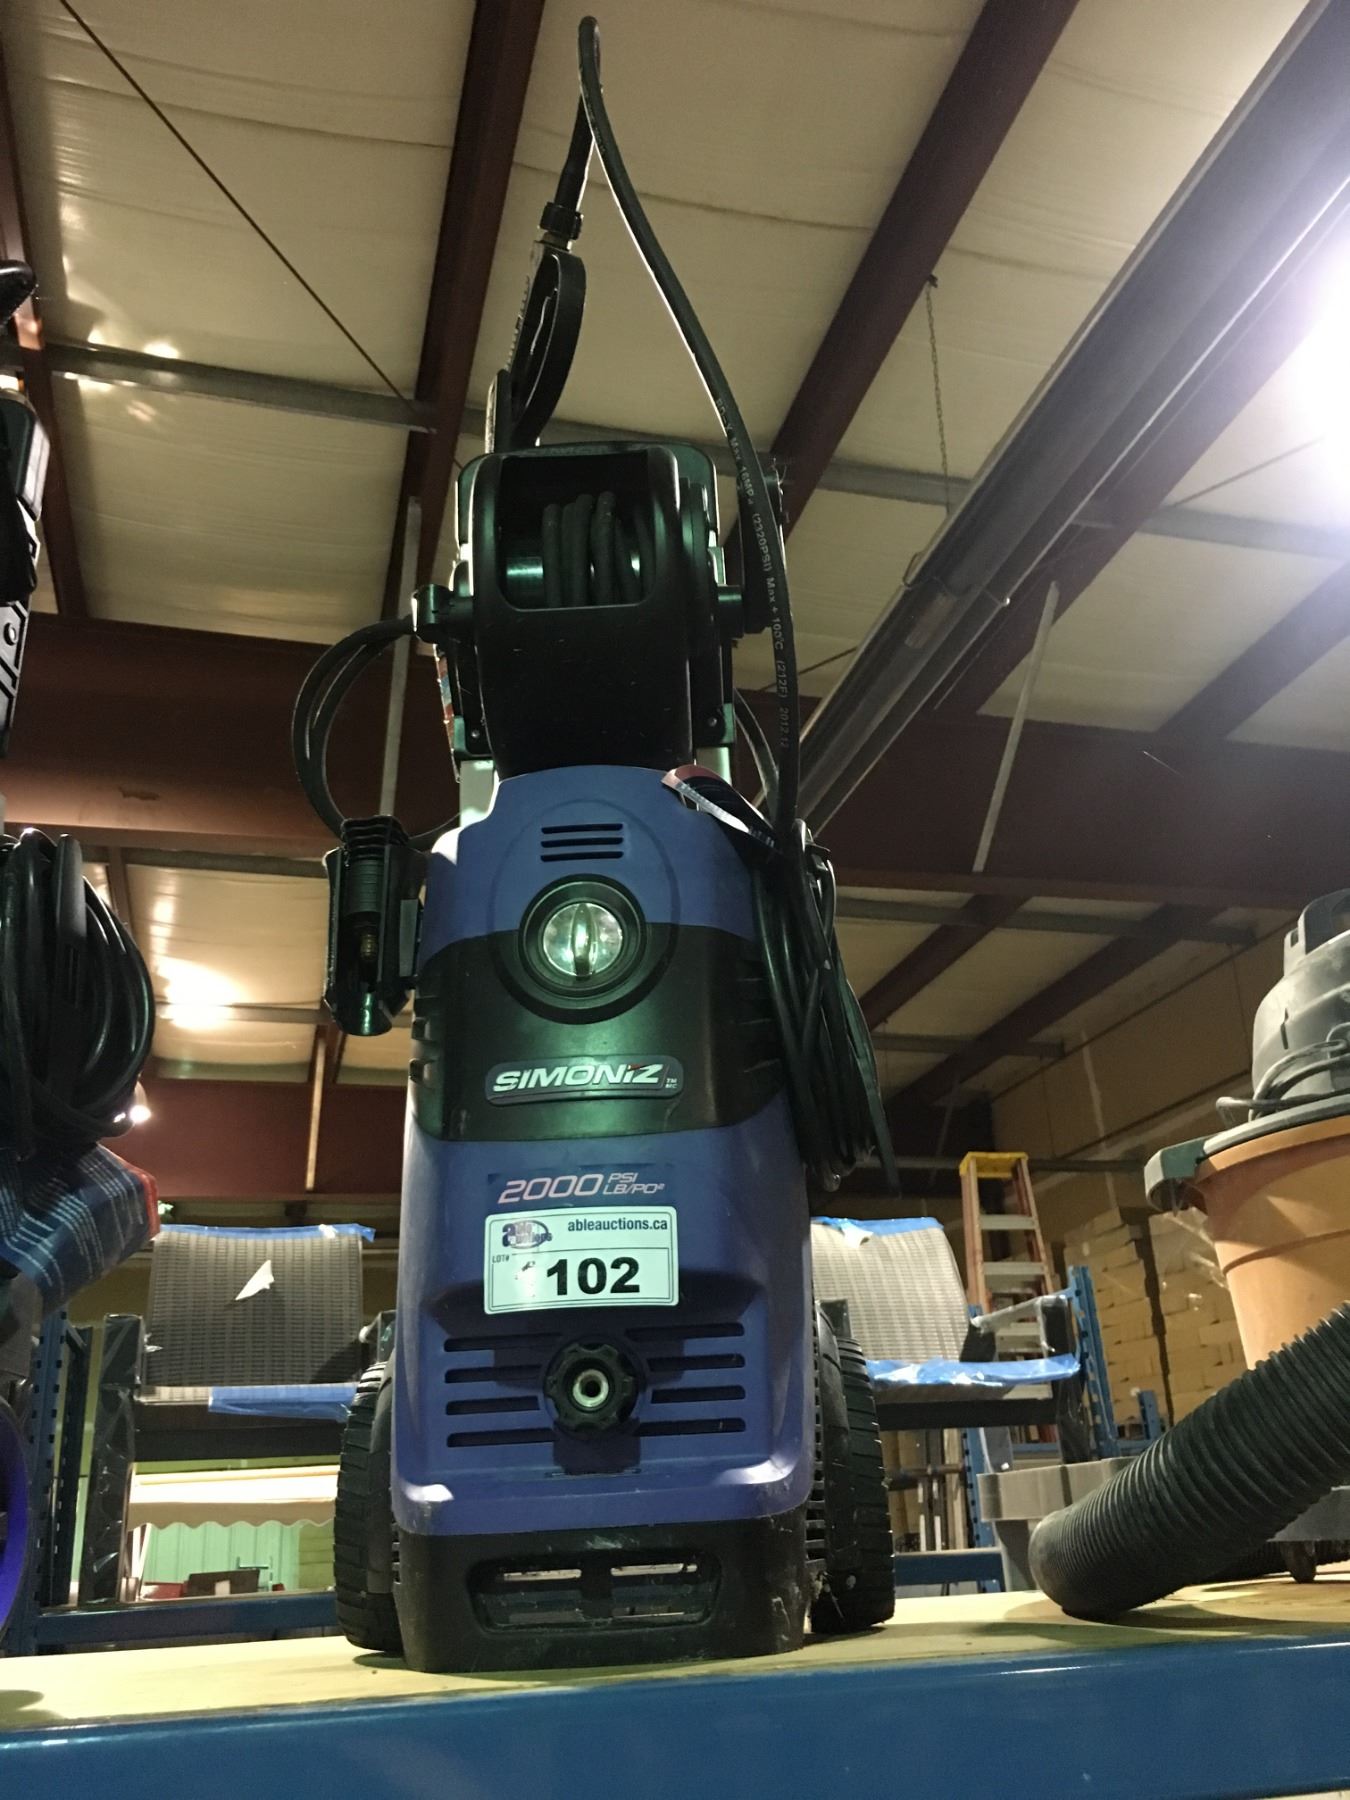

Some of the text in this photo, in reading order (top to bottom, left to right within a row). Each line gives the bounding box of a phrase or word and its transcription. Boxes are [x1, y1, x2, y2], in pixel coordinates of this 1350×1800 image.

[752, 513, 772, 572] (2320PSI)
[766, 577, 776, 603] Max
[776, 660, 788, 698] (212F)
[498, 1172, 638, 1204] 2000 PSI
[568, 1217, 668, 1232] ableauctions.ca
[547, 1256, 640, 1296] 102
